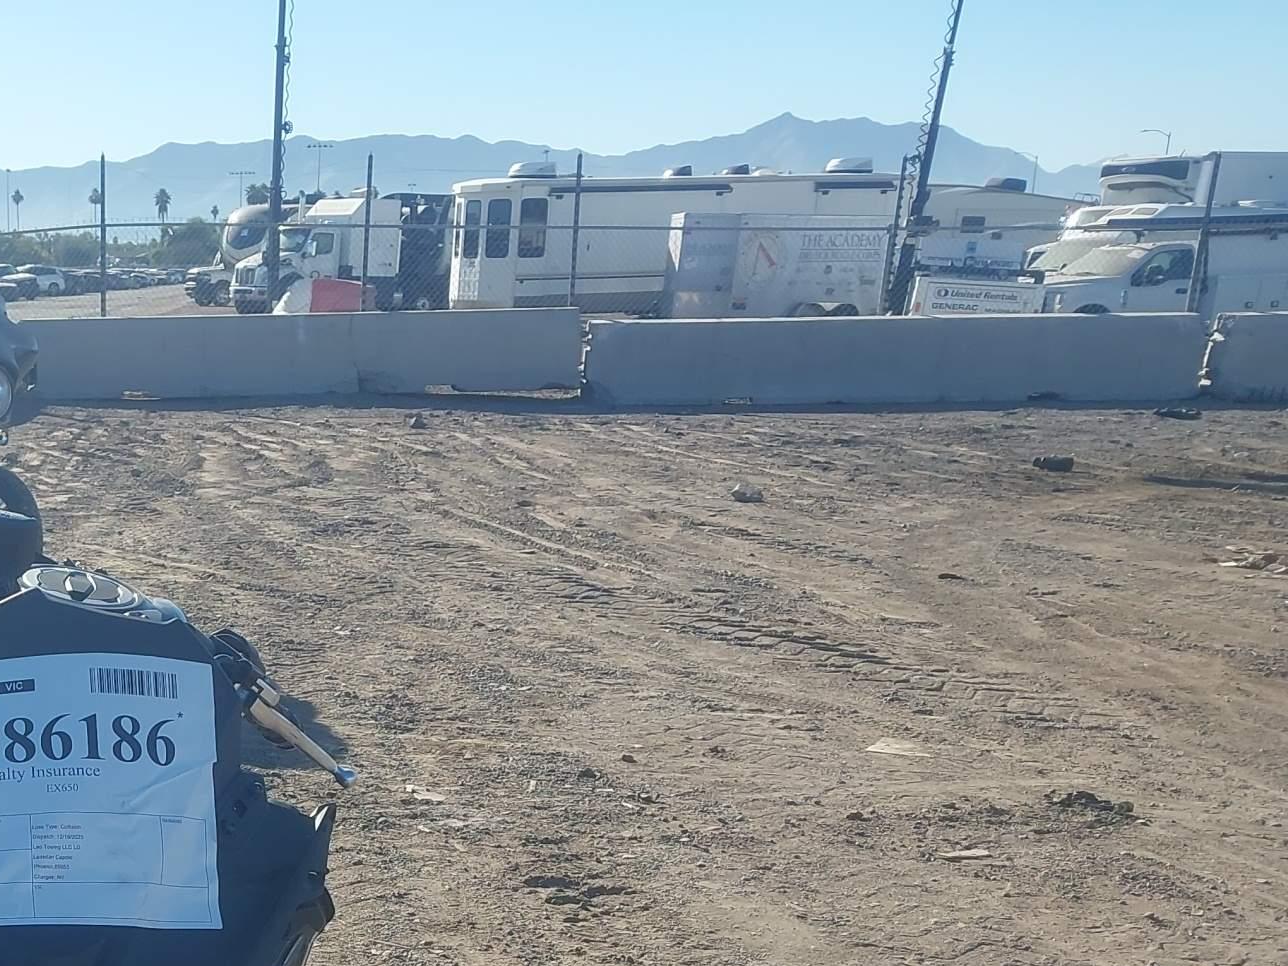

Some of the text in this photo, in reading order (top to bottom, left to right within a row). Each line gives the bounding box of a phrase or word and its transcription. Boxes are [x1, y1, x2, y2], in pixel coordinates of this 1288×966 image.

[825, 231, 886, 249] ACADEMY
[950, 289, 1018, 302] United Rentals
[931, 302, 979, 312] GENERAC
[4, 681, 24, 692] VIC
[30, 765, 101, 779] Insurance
[46, 783, 79, 794] EX650
